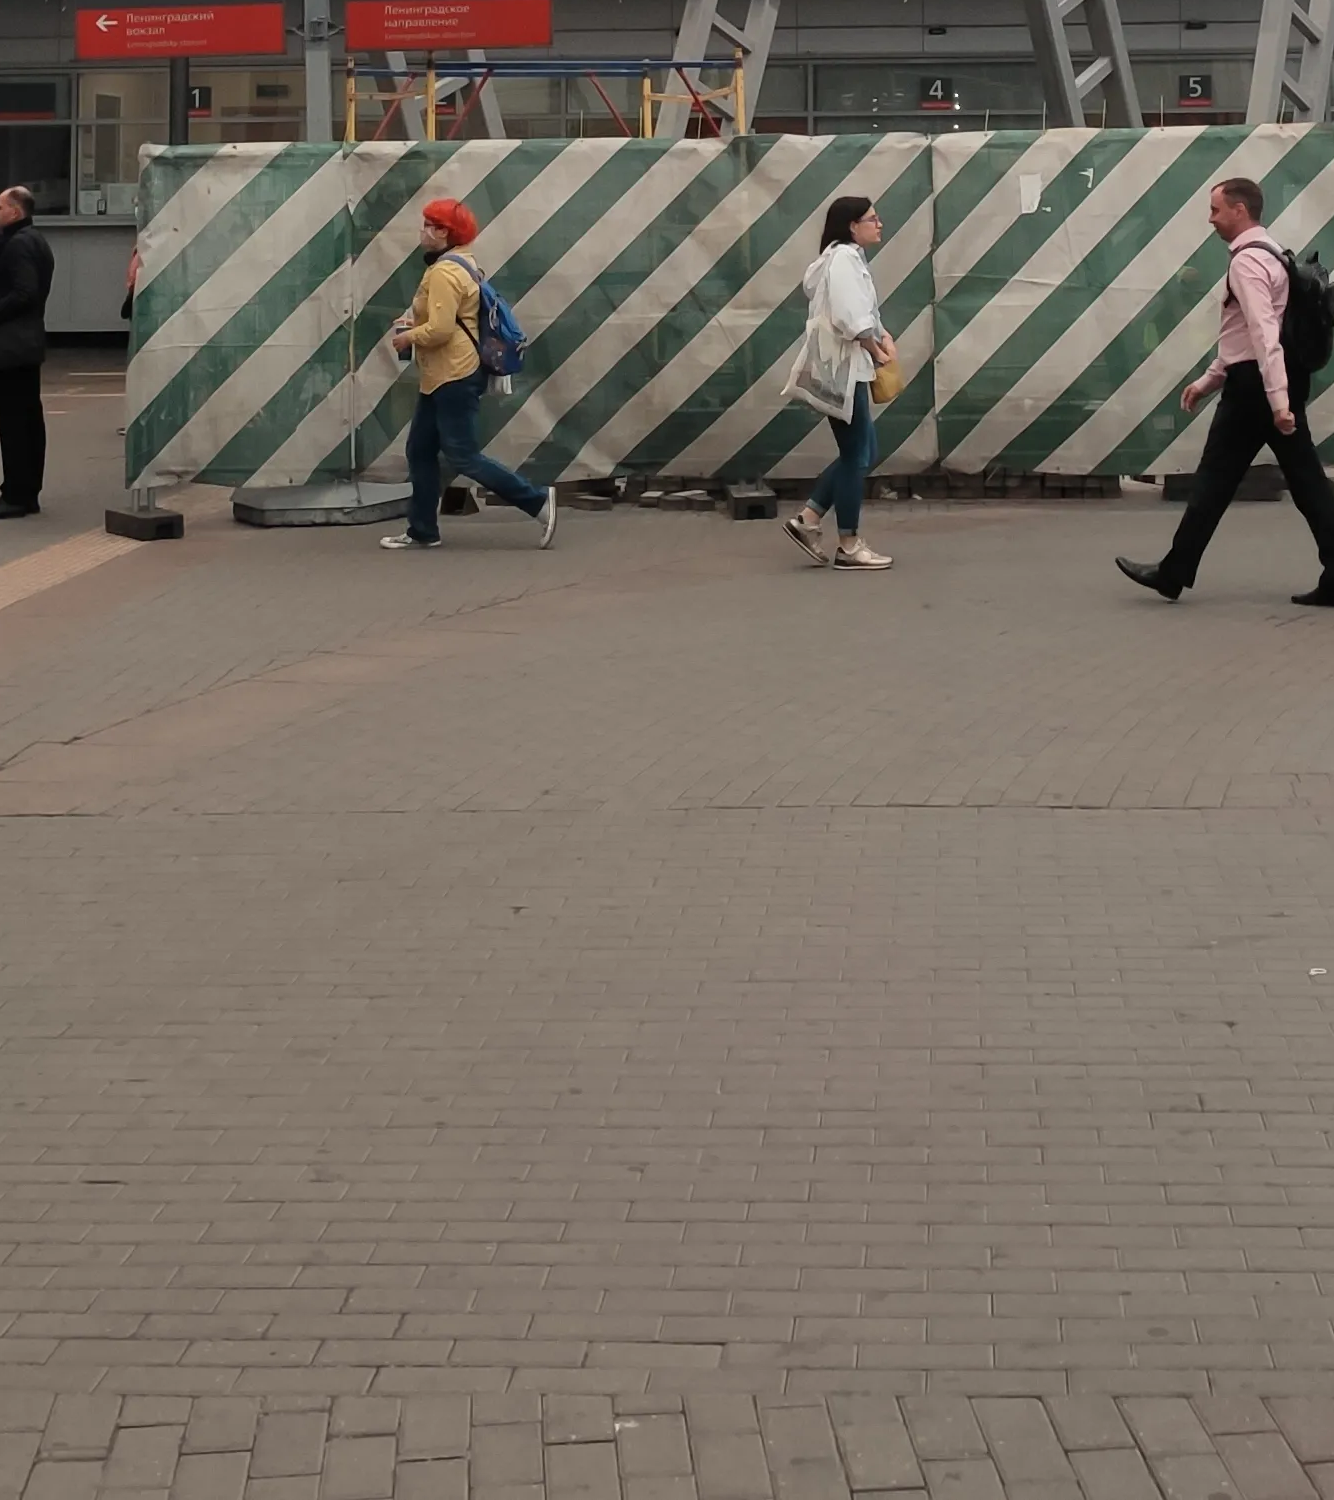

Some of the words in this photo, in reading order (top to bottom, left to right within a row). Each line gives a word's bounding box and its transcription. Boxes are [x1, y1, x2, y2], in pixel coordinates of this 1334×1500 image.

[125, 10, 215, 25] Ленинградский
[384, 5, 471, 17] Ленинградское
[384, 17, 459, 30] направление
[125, 26, 166, 37] вокзал
[928, 79, 943, 100] 4
[1189, 77, 1202, 97] 5
[191, 89, 200, 108] 1
